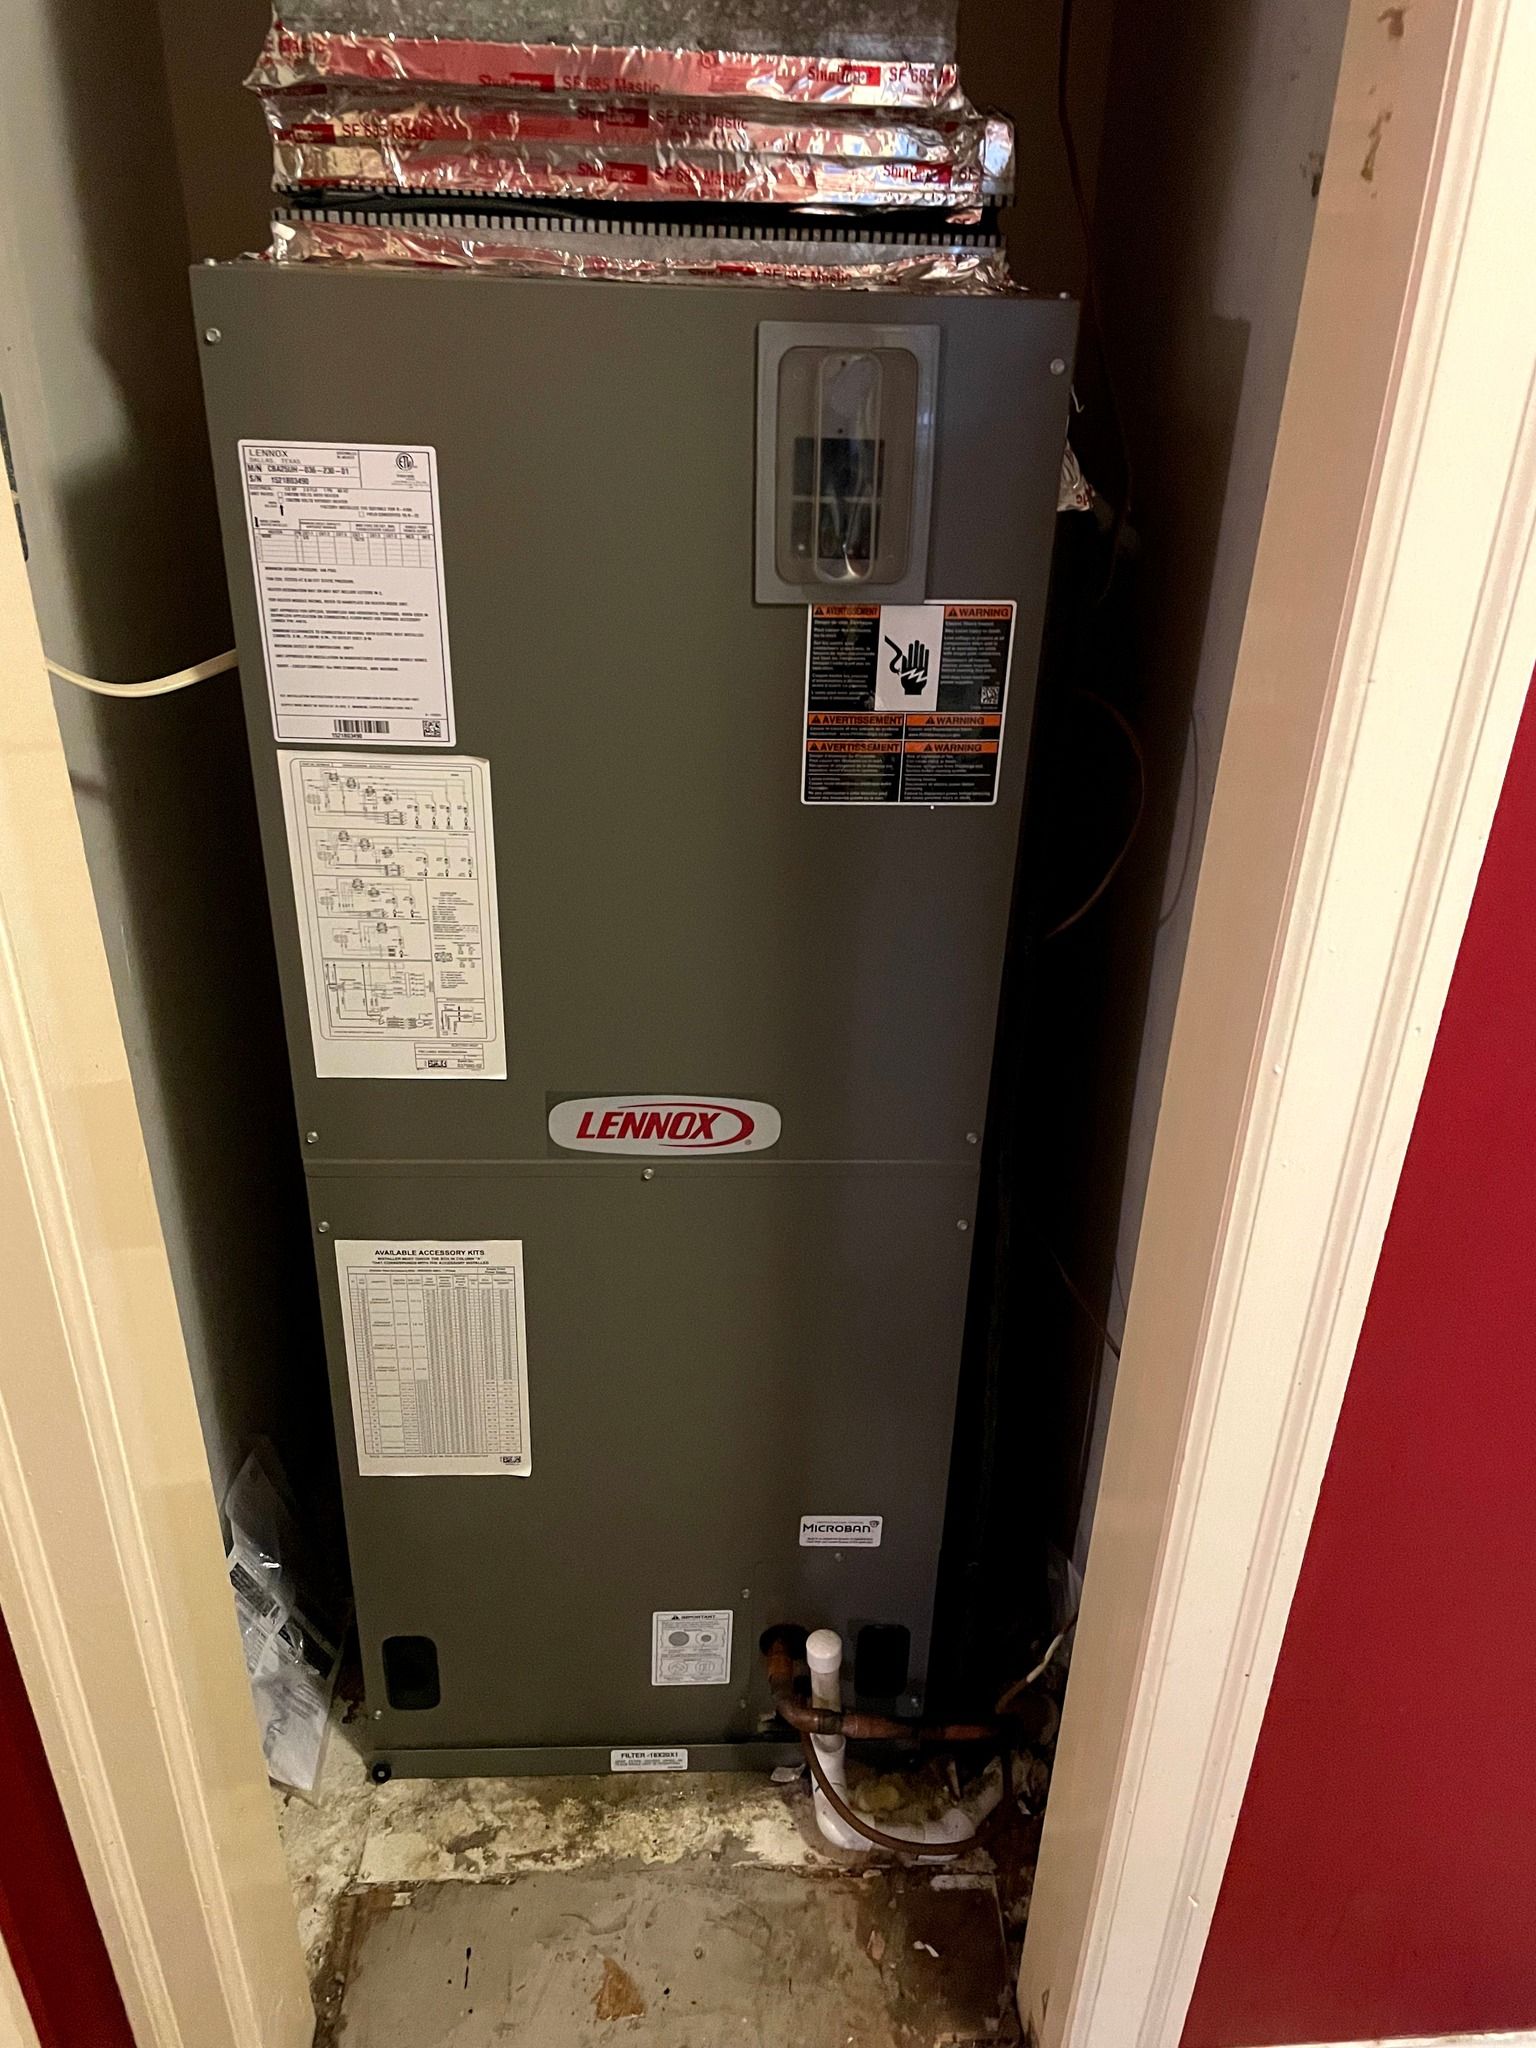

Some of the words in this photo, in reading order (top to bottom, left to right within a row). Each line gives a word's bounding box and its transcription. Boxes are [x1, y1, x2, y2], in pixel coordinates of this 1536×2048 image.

[889, 67, 907, 82] SF
[911, 68, 934, 84] 685
[249, 449, 288, 457] LENNOX
[249, 475, 262, 483] S/N
[959, 608, 1008, 617] WARNING
[823, 716, 902, 724] AVERTISSEMENT
[936, 717, 984, 725] WARNING
[821, 744, 899, 752] AVERTISSEMENT
[934, 744, 982, 752] WARNING
[576, 1111, 721, 1140] LENNOX
